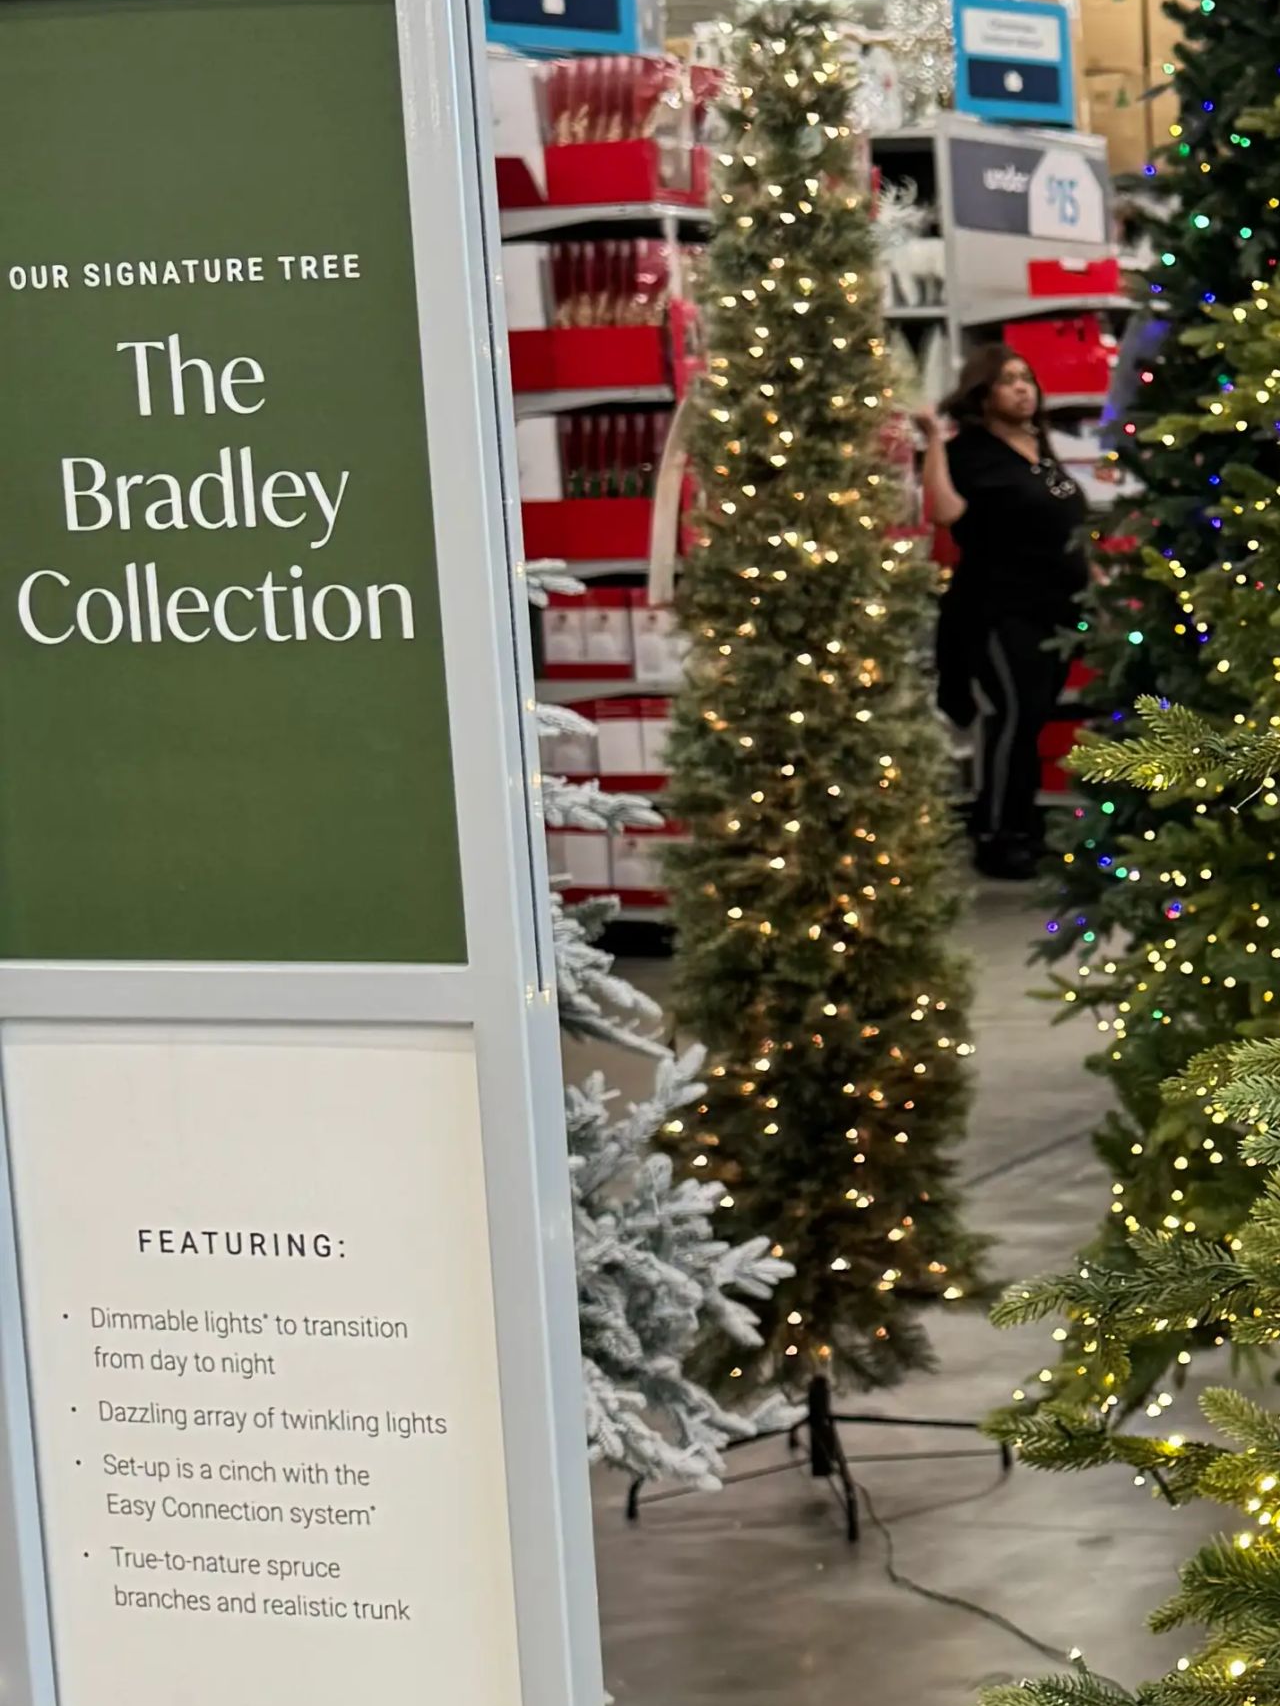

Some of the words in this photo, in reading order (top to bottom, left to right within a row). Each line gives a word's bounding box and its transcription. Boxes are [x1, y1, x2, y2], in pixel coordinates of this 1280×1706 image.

[9, 264, 69, 290] OUR
[84, 257, 264, 287] SIGNATURE
[278, 254, 361, 281] TREE
[116, 333, 267, 417] The
[61, 448, 349, 549] Bradley
[17, 565, 415, 645] Collection
[138, 1229, 347, 1259] FEATURING:
[90, 1307, 199, 1334] Dimmable
[275, 1315, 298, 1337] to
[303, 1315, 408, 1340] transition
[93, 1348, 145, 1372] from
[150, 1350, 188, 1378] day
[194, 1352, 214, 1374] to
[219, 1352, 276, 1381] night
[98, 1400, 188, 1432] Dazzling
[193, 1407, 246, 1436] array
[252, 1407, 276, 1431] of
[280, 1407, 380, 1438] twinkling
[386, 1413, 447, 1439] lights
[103, 1454, 170, 1483] Set-up
[175, 1458, 194, 1479] is
[200, 1464, 212, 1481] a
[219, 1457, 275, 1483] cinch
[282, 1460, 328, 1485] with
[334, 1462, 370, 1485] the
[106, 1494, 156, 1524] Easy
[161, 1497, 284, 1524] Connection
[110, 1547, 260, 1577] True-to-nature
[266, 1557, 341, 1585] spruce
[114, 1586, 212, 1614] branches
[217, 1590, 256, 1616] and
[262, 1591, 347, 1621] realistic
[353, 1596, 410, 1621] trunk
